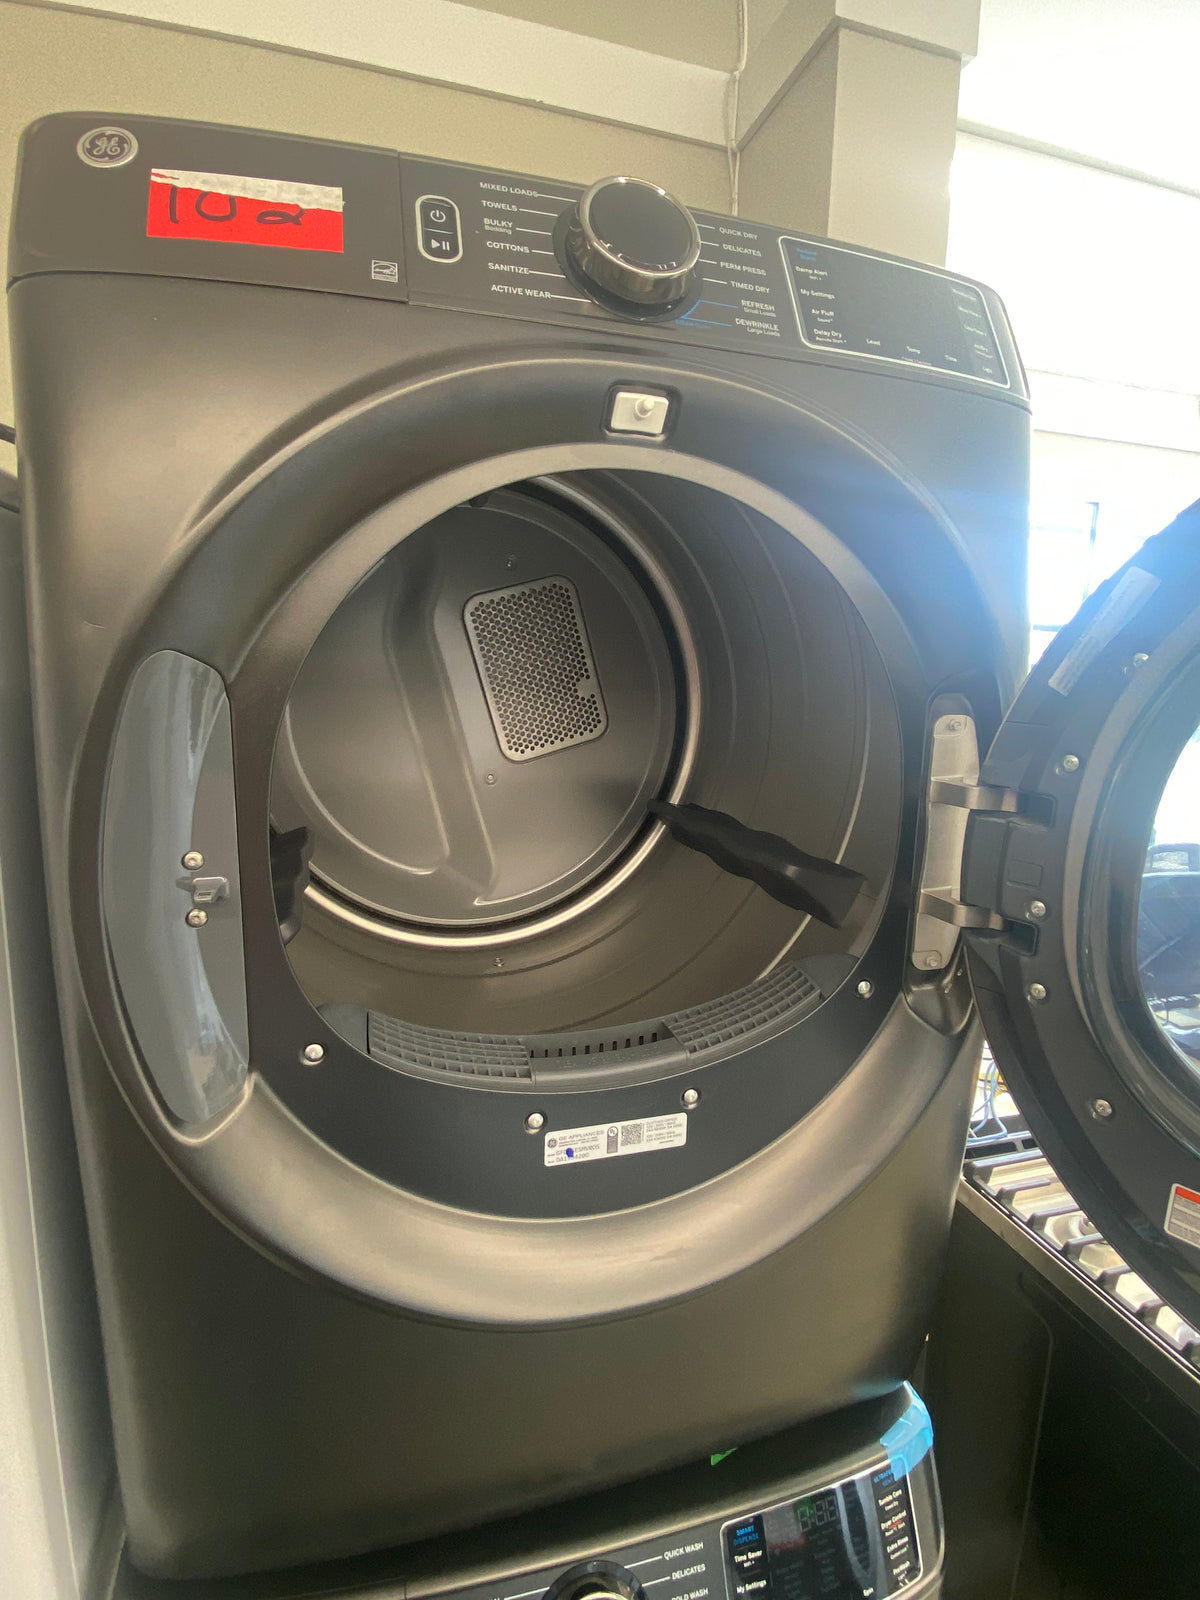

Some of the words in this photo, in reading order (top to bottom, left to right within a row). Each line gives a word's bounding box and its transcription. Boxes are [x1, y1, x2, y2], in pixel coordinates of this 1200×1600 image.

[479, 182, 508, 192] MIXED
[509, 187, 539, 197] LOADS
[481, 200, 518, 212] TOWELS
[483, 217, 513, 228] BULKY
[484, 225, 512, 235] Bedding
[719, 226, 743, 237] QUICK
[743, 232, 758, 240] DRY
[486, 240, 530, 253] COTTONS
[722, 243, 762, 256] DELICATES
[488, 262, 530, 275] SANITIZE
[720, 261, 741, 271] PERM
[742, 265, 767, 276] PRESS
[491, 284, 523, 295] ACTIVE
[524, 289, 552, 299] WEAR
[730, 280, 754, 291] TIMED
[755, 285, 770, 293] DRY
[741, 299, 775, 311] REFRESH
[735, 318, 780, 331] DEWRINKLE
[736, 1525, 755, 1536] SMART
[664, 1547, 685, 1560] QUICK
[685, 1542, 704, 1553] WASH
[734, 1554, 748, 1563] Time
[747, 1550, 763, 1560] Saver
[671, 1563, 706, 1580] DELICATES
[736, 1585, 745, 1594] My
[745, 1579, 767, 1591] Settings
[689, 1587, 709, 1600] WASH
